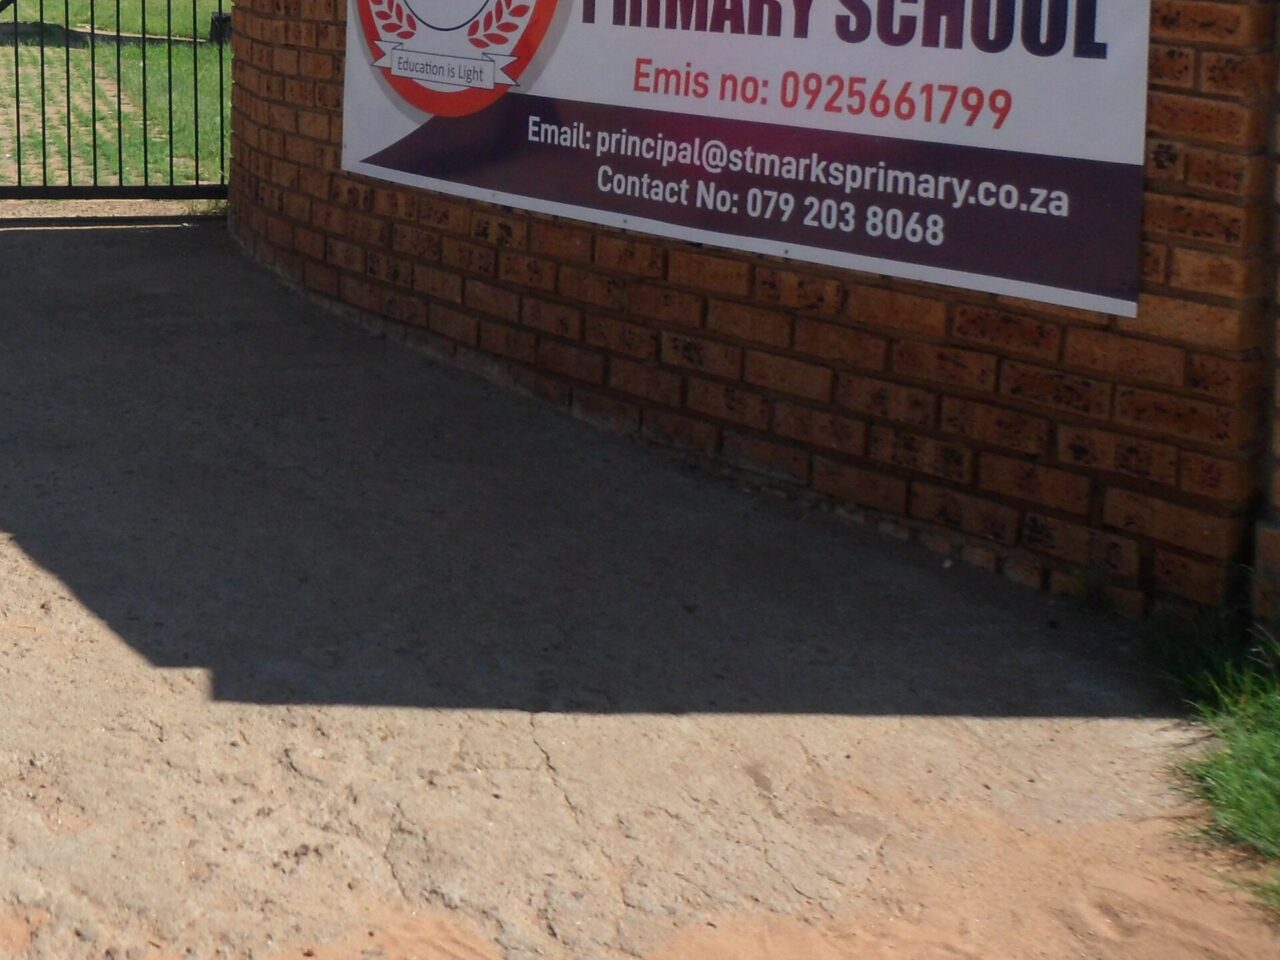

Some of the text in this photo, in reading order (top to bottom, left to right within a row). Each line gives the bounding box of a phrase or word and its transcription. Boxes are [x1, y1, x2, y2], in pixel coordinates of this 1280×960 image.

[397, 55, 484, 84] Education is Light
[633, 58, 1014, 130] Emis no: 0925661799
[527, 116, 1070, 217] Email: principal@stmarksprimary.co.za
[597, 165, 945, 246] Contact No: 079 203 8068
